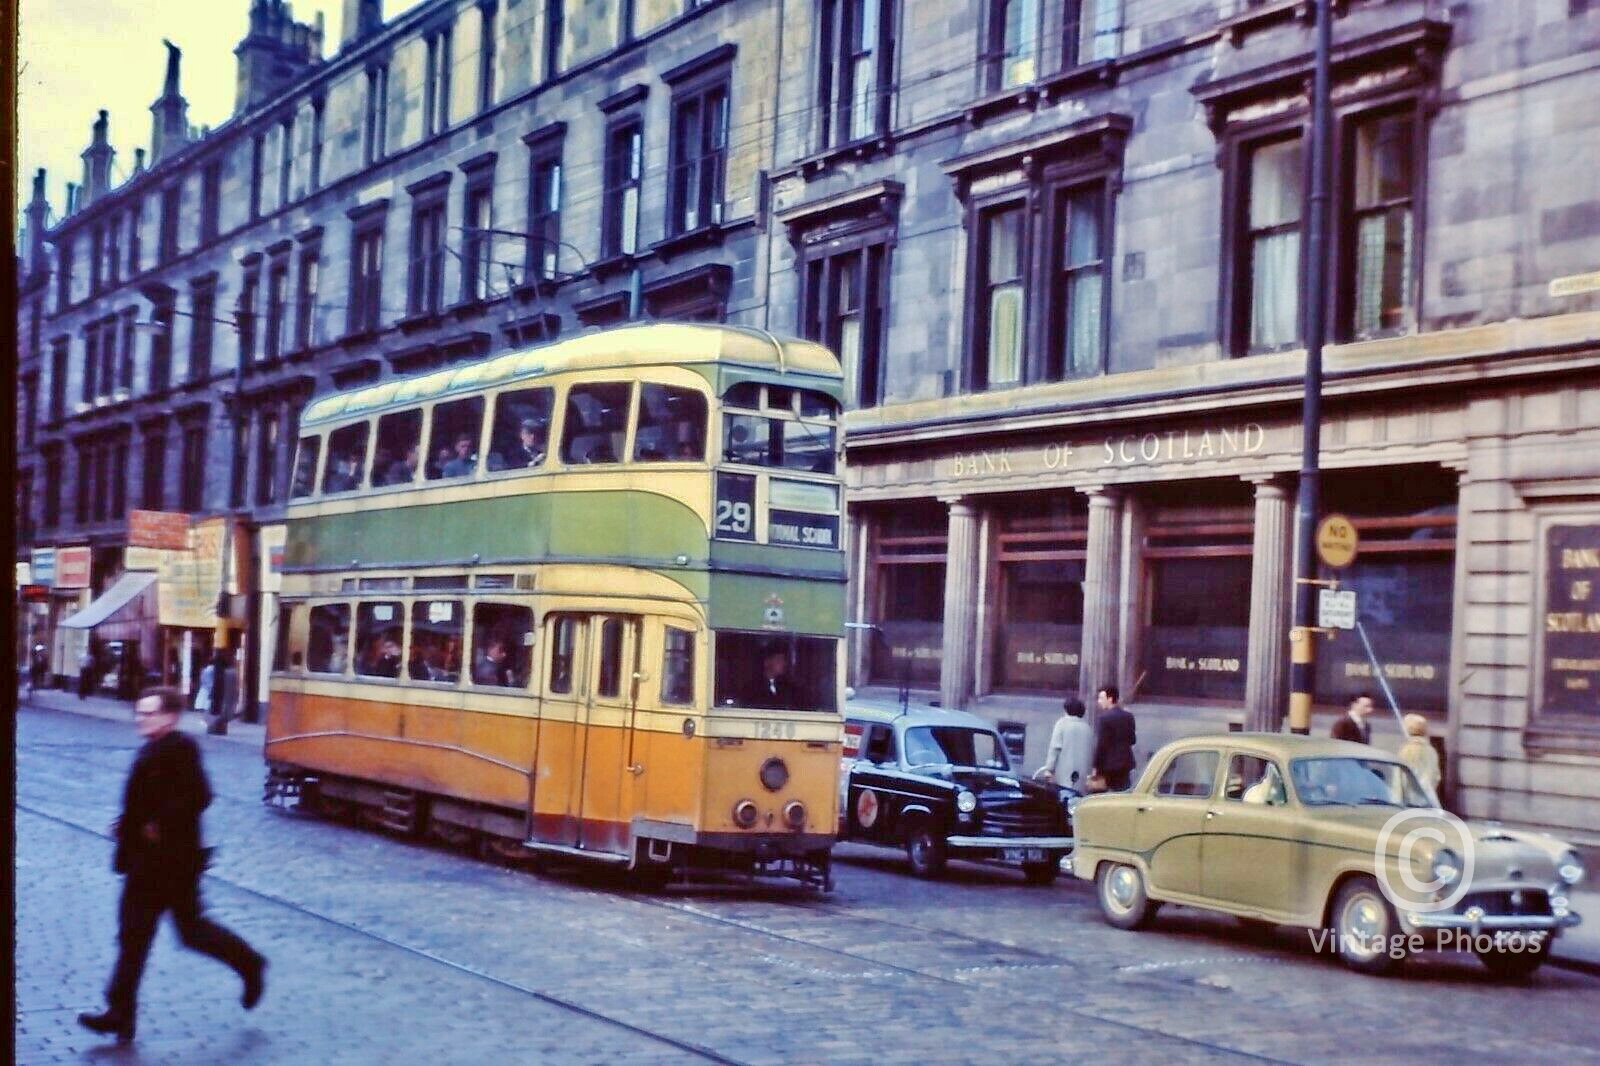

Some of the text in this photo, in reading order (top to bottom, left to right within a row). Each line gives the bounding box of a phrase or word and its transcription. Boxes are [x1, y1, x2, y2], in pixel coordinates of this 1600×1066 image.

[953, 422, 1265, 477] BANK OF SCOTLAND
[717, 499, 751, 534] 29
